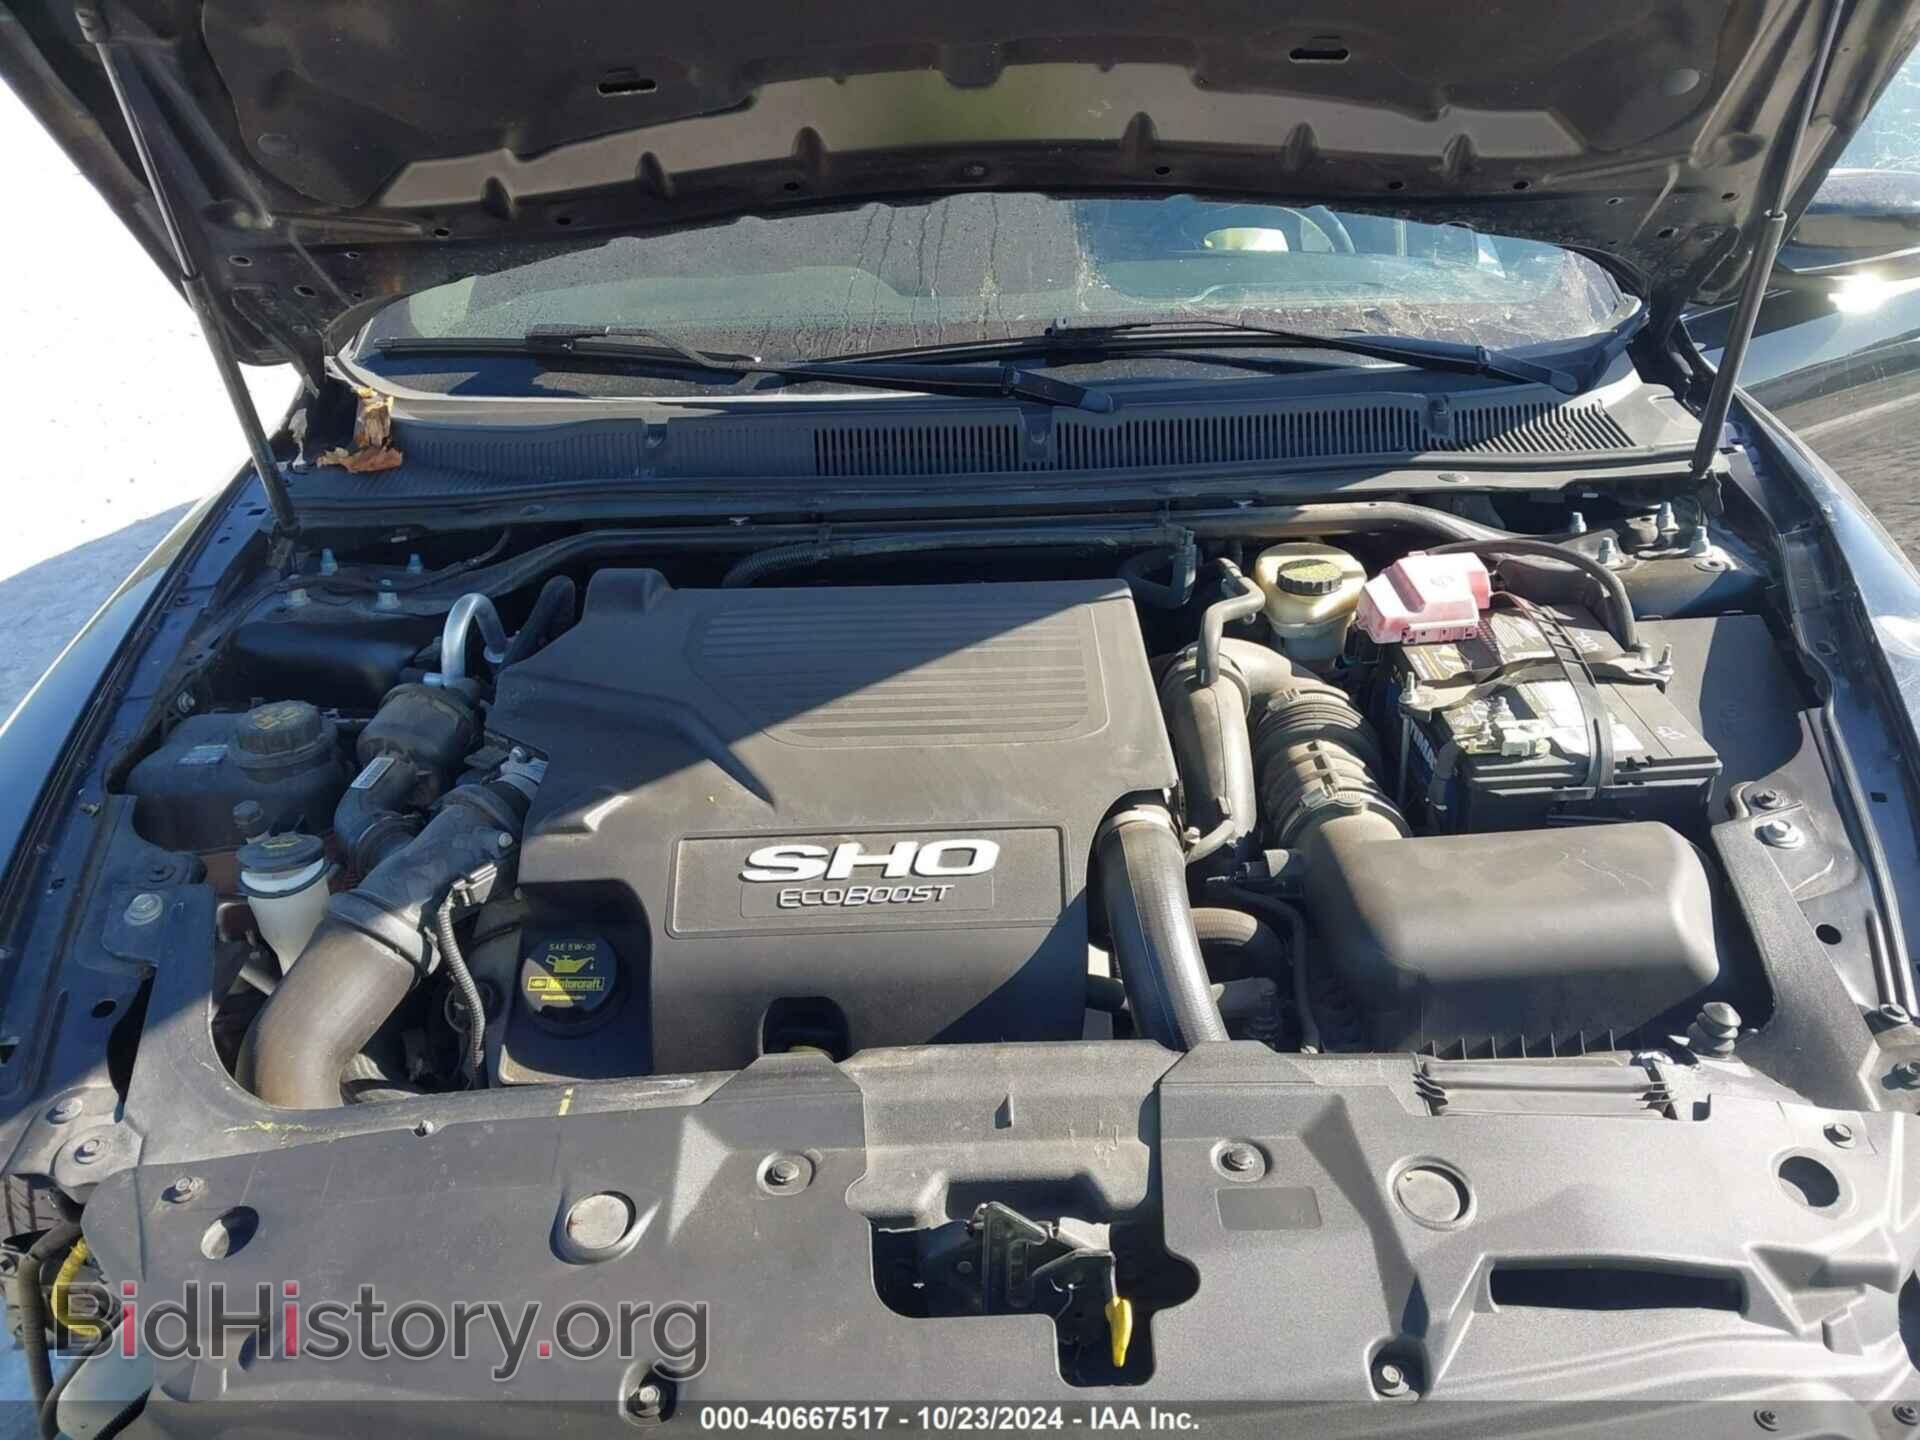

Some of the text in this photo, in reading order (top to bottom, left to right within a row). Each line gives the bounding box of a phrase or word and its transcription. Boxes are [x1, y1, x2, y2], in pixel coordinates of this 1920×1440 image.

[741, 838, 1000, 882] SHO
[548, 943, 566, 951] SAE
[547, 977, 601, 990] Motorcraft
